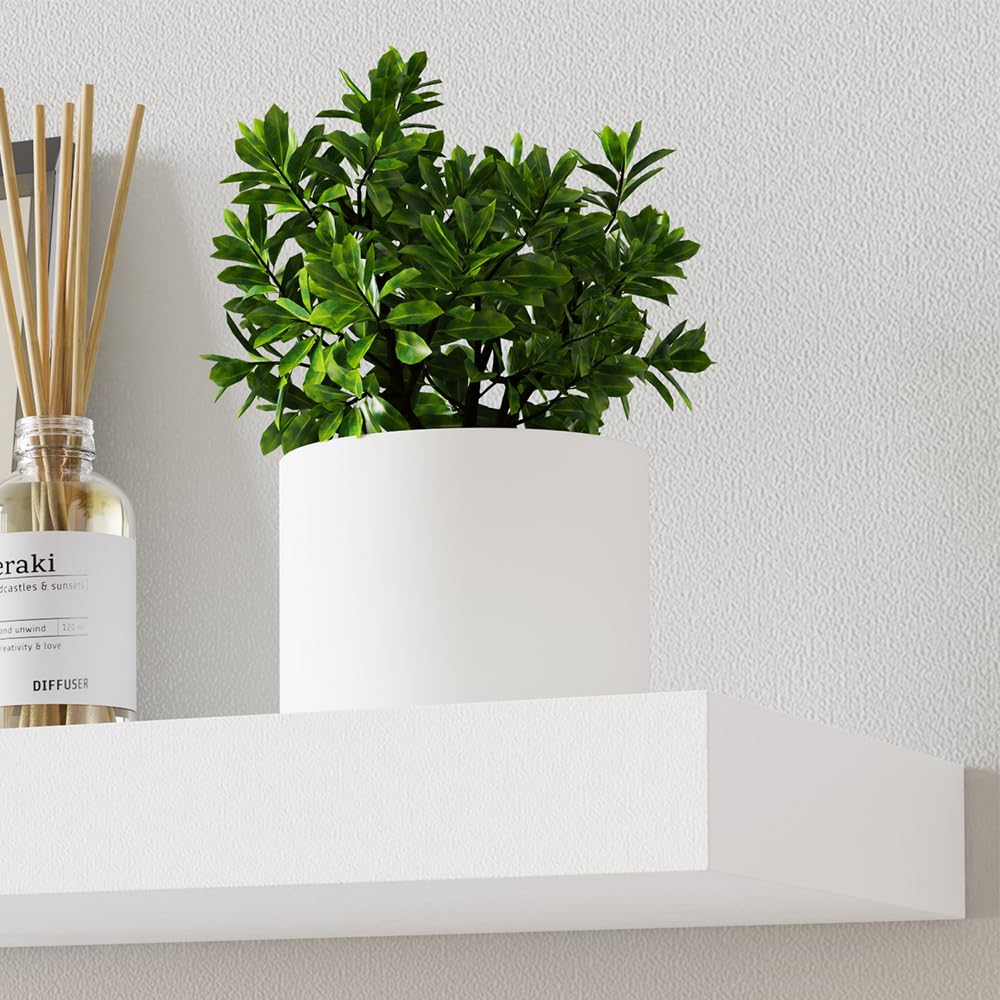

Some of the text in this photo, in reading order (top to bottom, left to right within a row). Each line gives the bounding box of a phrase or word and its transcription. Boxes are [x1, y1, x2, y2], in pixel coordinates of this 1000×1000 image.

[41, 581, 47, 591] &
[15, 625, 47, 634] unwind
[35, 642, 41, 650] &
[44, 642, 62, 650] love
[33, 678, 89, 692] DIFFUSER
